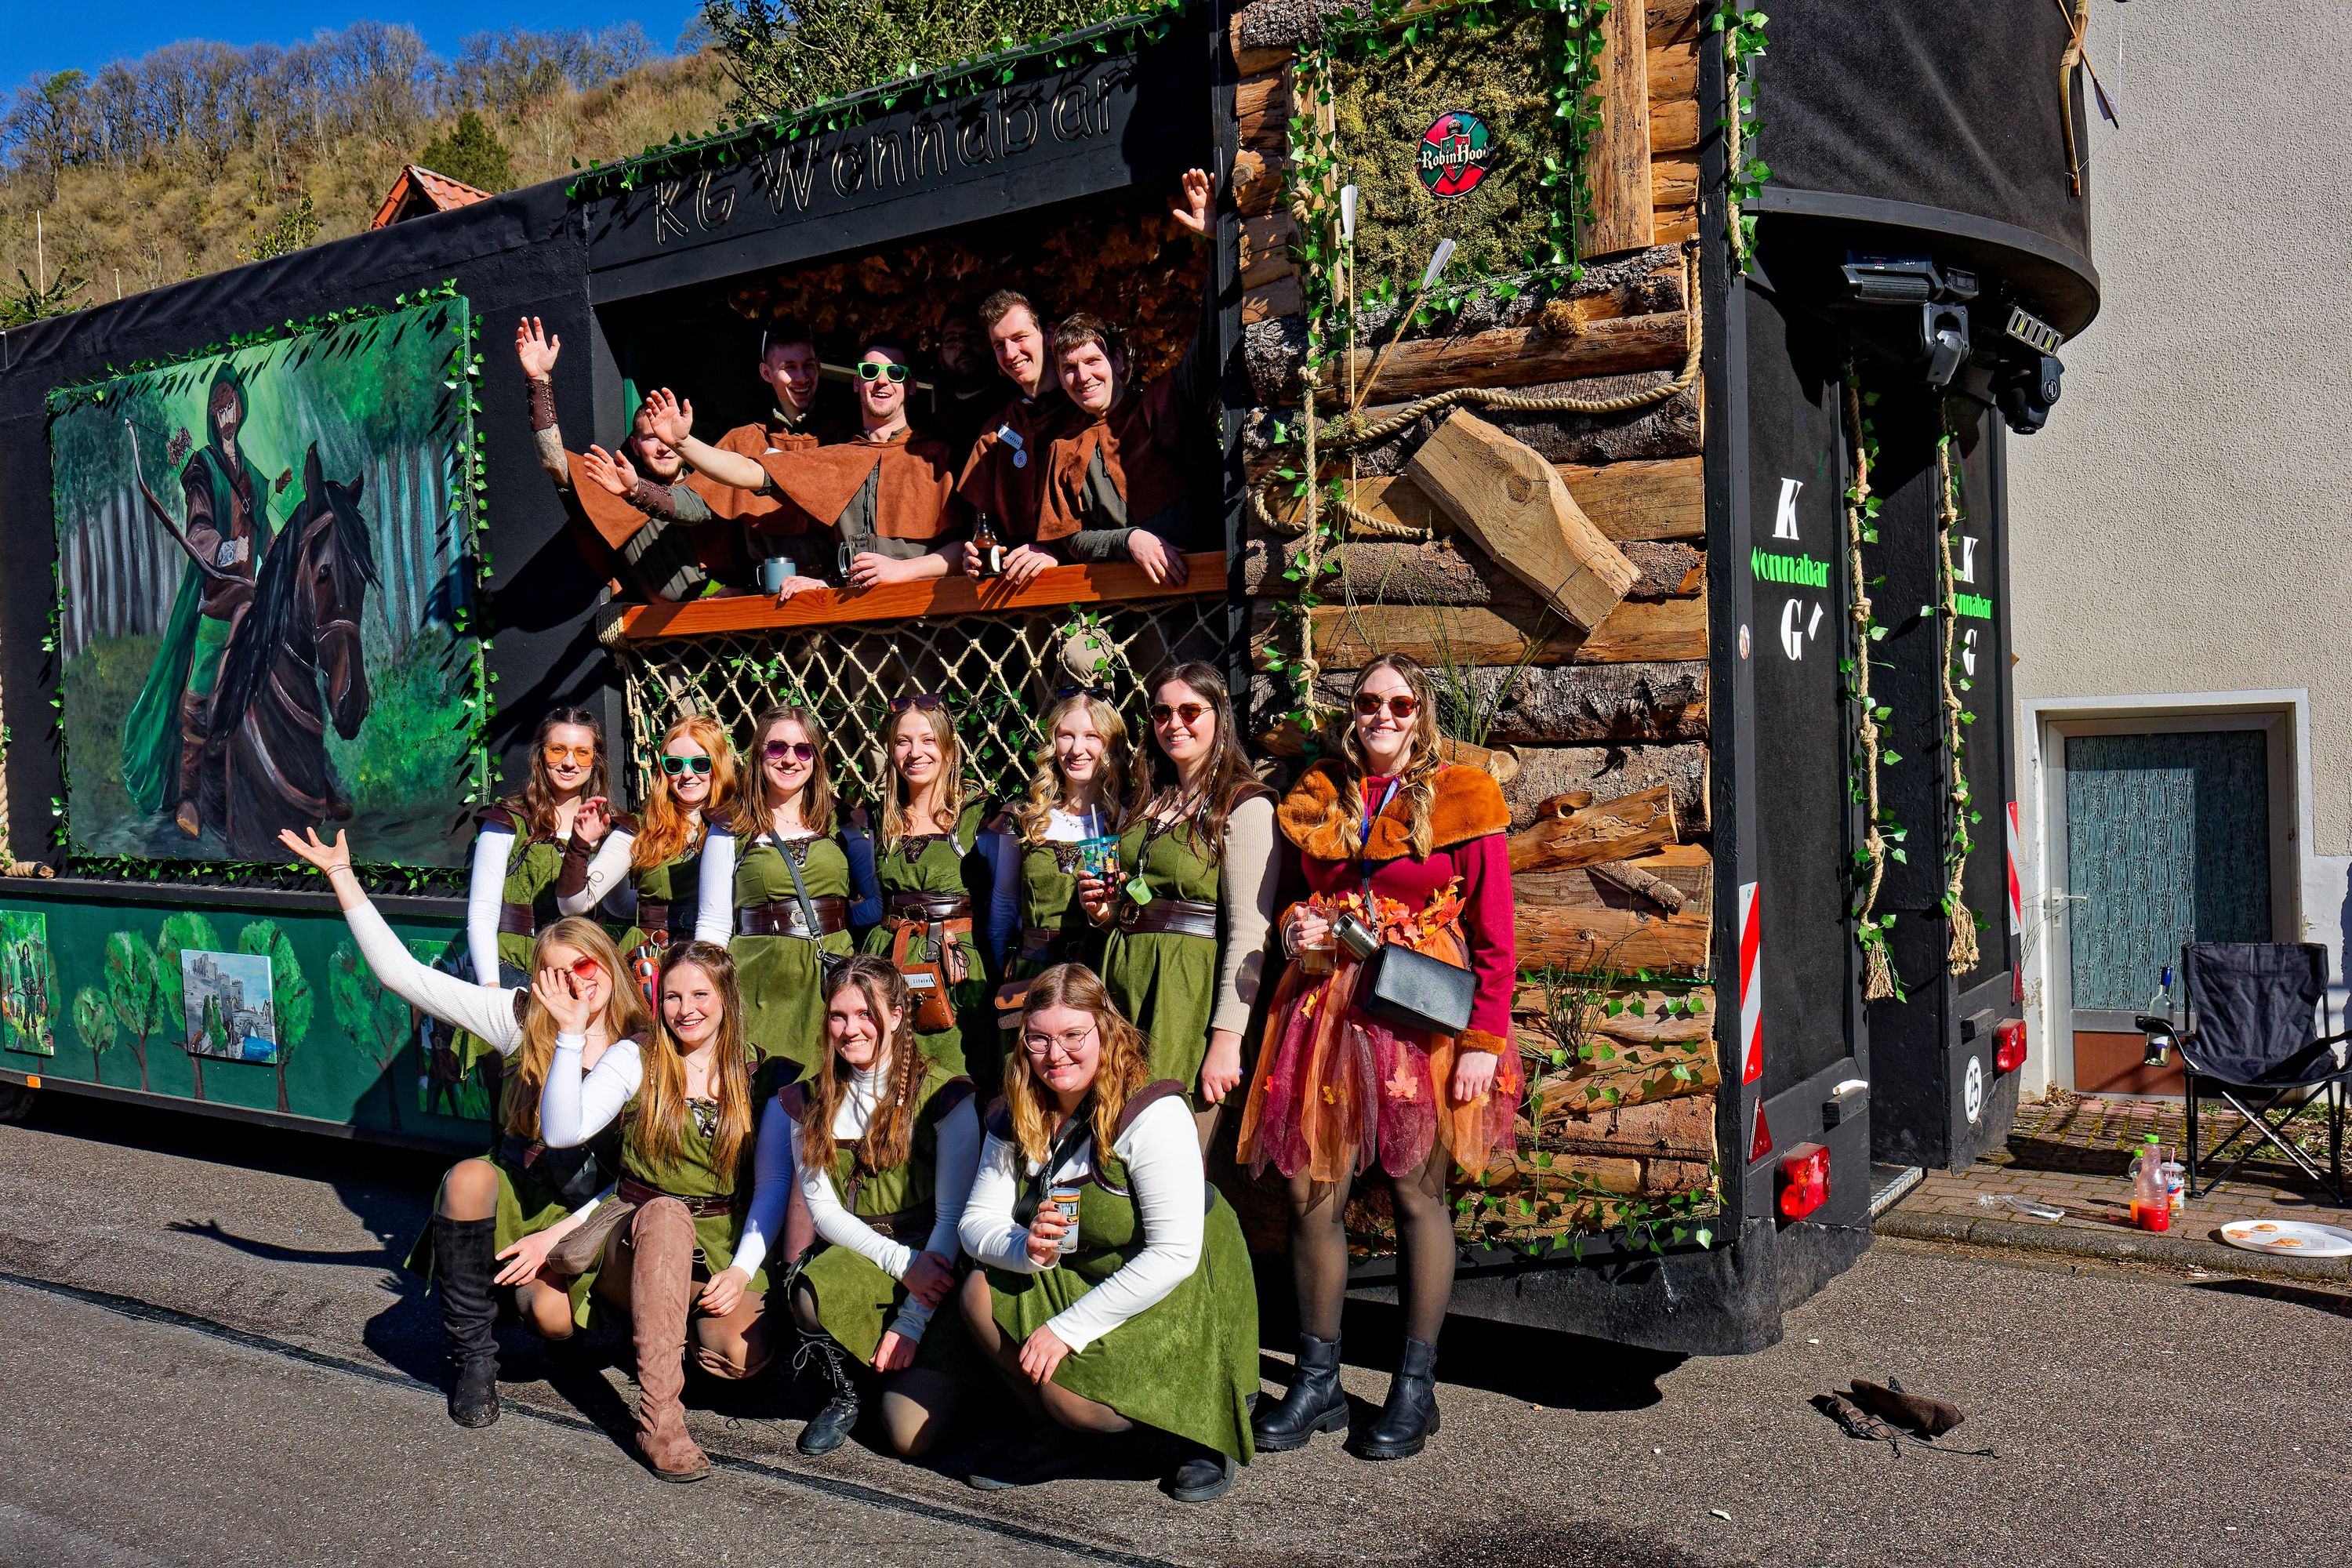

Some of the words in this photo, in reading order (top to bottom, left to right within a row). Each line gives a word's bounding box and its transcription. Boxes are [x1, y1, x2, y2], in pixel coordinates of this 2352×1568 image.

[655, 163, 735, 245] KG
[759, 71, 1131, 214] Wonnabar
[1773, 477, 1803, 540] K
[1962, 536, 1979, 584] K
[1946, 593, 1992, 619] onnabar
[1969, 1067, 1979, 1112] 25
